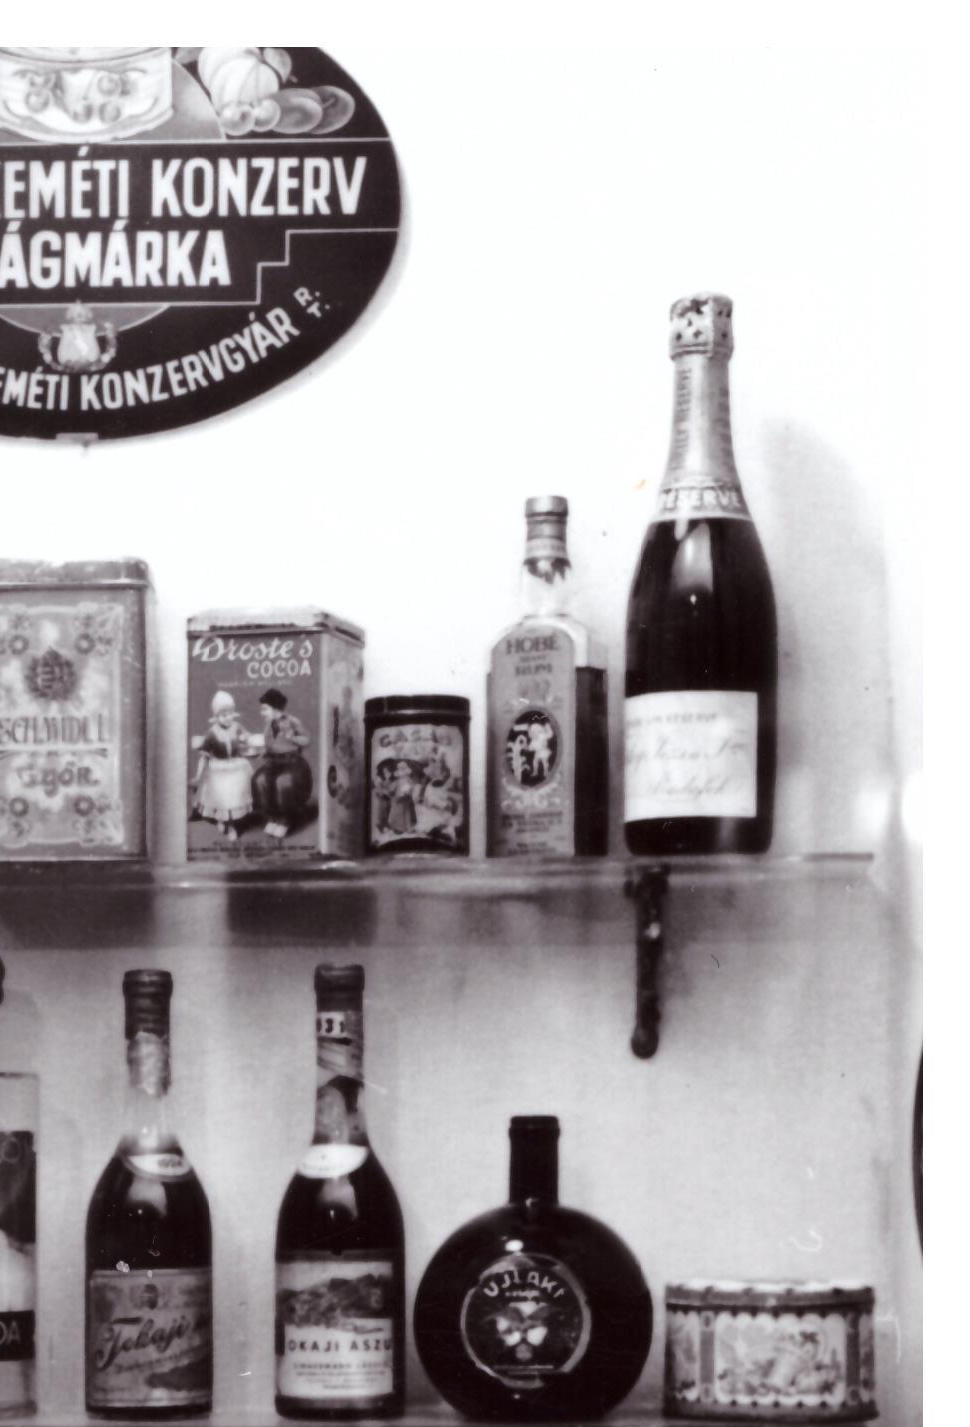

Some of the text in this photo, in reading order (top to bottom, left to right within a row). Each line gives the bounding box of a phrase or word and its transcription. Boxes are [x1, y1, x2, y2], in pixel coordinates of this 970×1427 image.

[151, 156, 367, 217] KONZERV
[80, 305, 301, 411] KONZERVGYÁR
[192, 636, 313, 662] Droste's
[247, 659, 312, 679] COCOA
